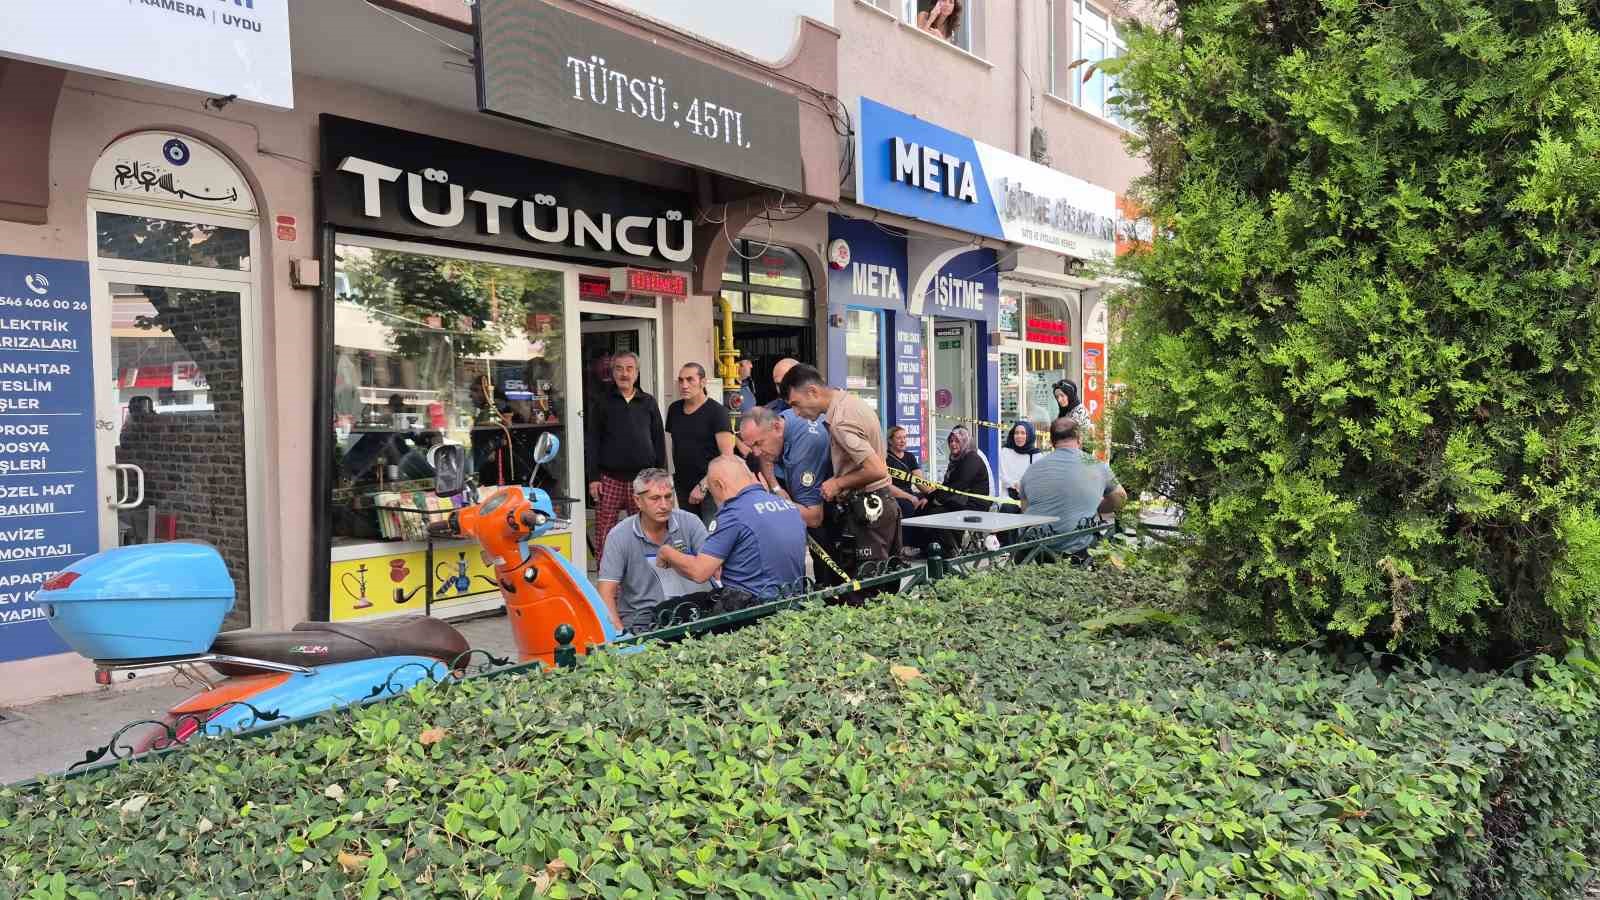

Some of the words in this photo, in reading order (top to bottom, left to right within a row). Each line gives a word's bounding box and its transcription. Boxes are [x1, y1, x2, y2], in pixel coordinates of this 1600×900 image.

[222, 13, 262, 32] UYDU
[566, 55, 667, 122] TÜTSÜ
[892, 135, 978, 205] META
[337, 155, 694, 263] TÜTÜNCÜ
[852, 262, 900, 300] META
[934, 271, 985, 311] İŞİTME
[0, 297, 22, 307] 546
[25, 299, 50, 308] 406
[53, 300, 70, 310] 00
[73, 301, 88, 311] 26
[0, 318, 69, 332] LEKTRİK
[0, 379, 52, 392] ESLİM
[0, 398, 40, 412] ŞLER
[0, 457, 46, 474] ŞLERİ
[42, 484, 75, 496] HAT
[0, 528, 45, 542] AVİZE
[0, 543, 72, 560] MONTAJI
[0, 591, 21, 605] EV
